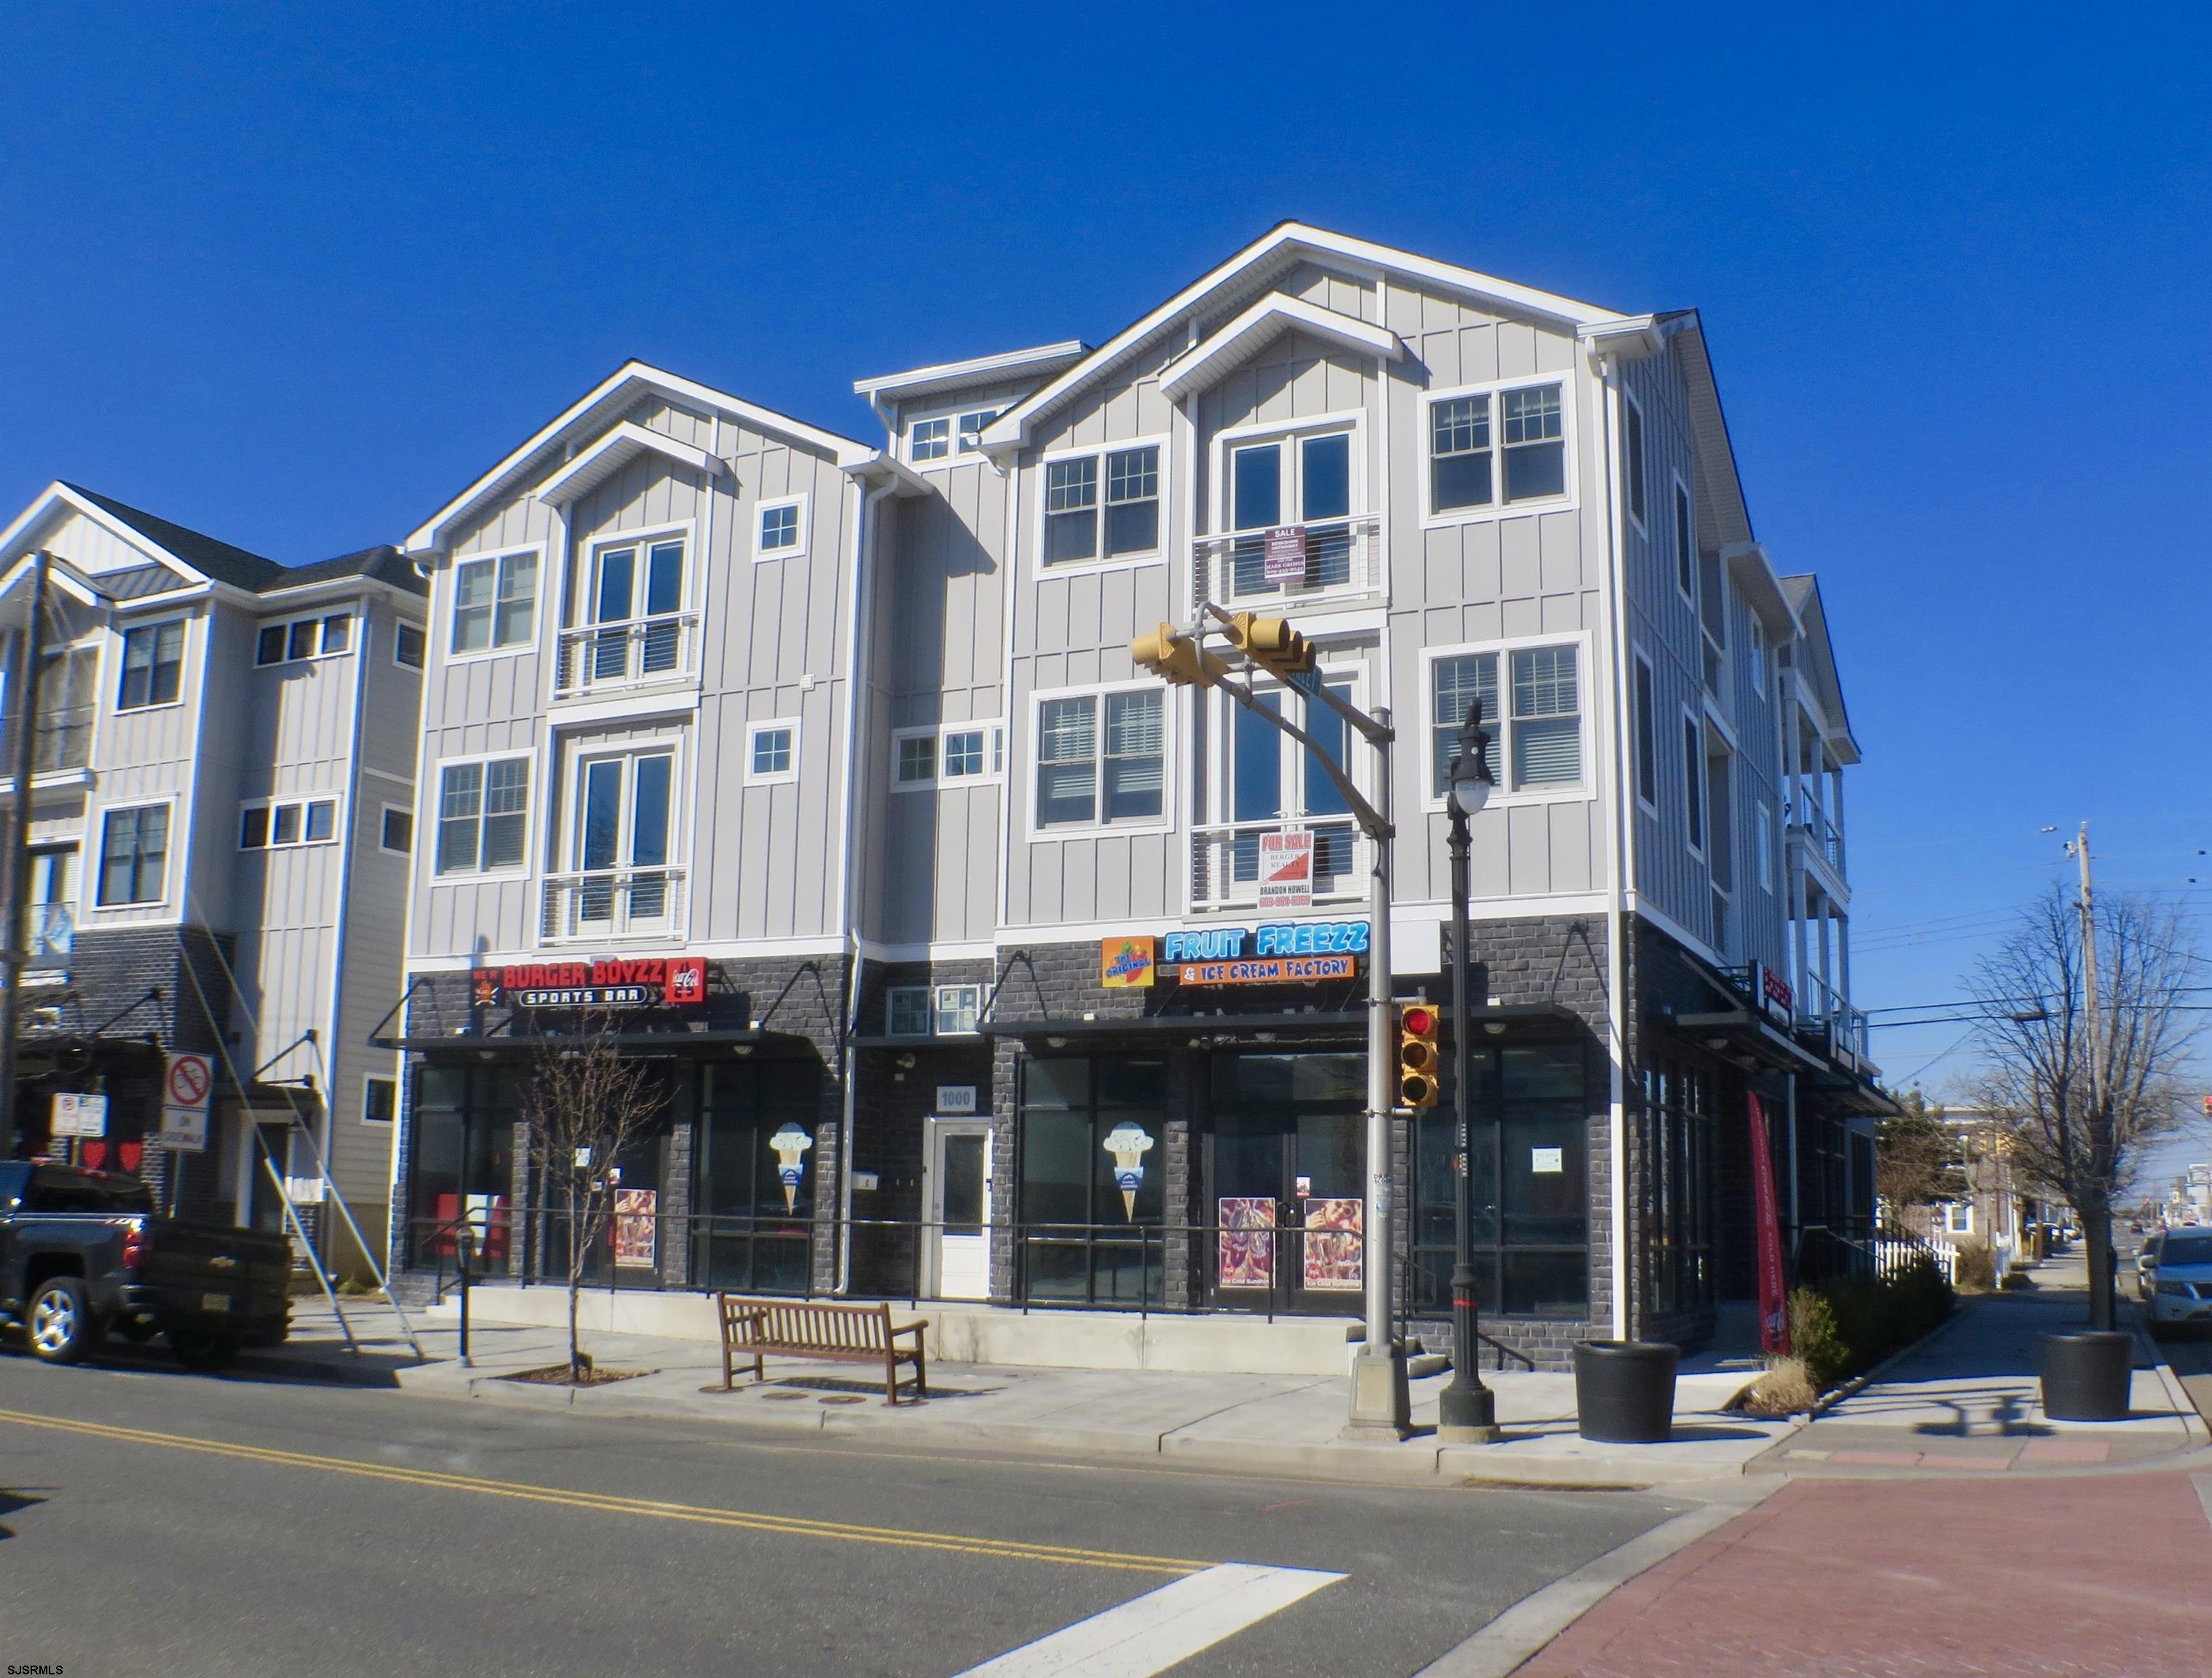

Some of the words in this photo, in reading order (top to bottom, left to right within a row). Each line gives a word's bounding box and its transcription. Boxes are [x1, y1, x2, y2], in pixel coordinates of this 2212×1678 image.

[1275, 529, 1295, 537] SALE
[1262, 835, 1283, 851] FOR
[1285, 832, 1311, 850] SALE
[1260, 885, 1287, 895] BRANDON
[1288, 884, 1310, 894] HOWELL
[1165, 929, 1245, 960] FRUIT
[1256, 921, 1370, 956] FREEZZ
[503, 962, 586, 988] BURGER
[592, 958, 664, 985] BOYZZ
[1106, 958, 1151, 977] ORIGINAL
[1184, 967, 1195, 982] &
[1201, 965, 1224, 980] ICE
[1230, 962, 1279, 980] CREAM
[1286, 960, 1349, 977] FACTORY
[527, 991, 593, 1004] SPORTS
[605, 989, 638, 1001] BAR
[942, 1091, 970, 1106] 1000
